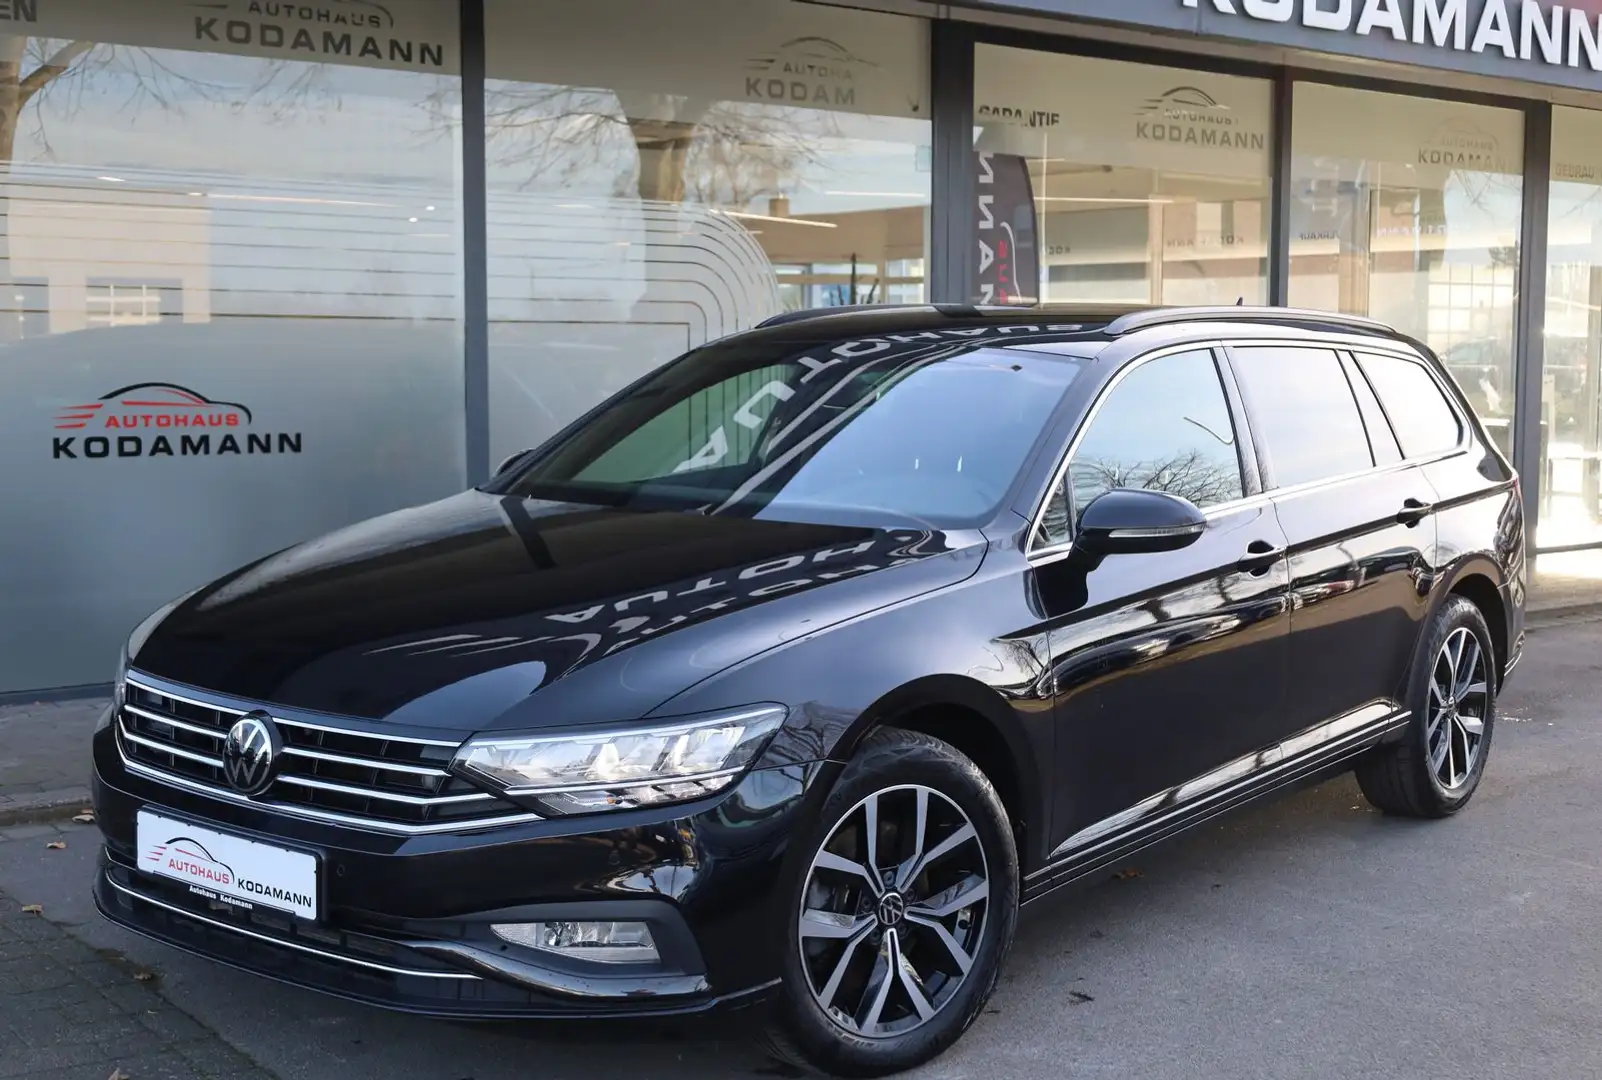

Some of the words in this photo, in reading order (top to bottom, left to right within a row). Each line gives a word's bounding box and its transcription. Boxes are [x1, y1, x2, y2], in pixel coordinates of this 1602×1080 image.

[249, 0, 381, 29] AUTOHAUS
[195, 16, 443, 66] KODAMANN
[1183, 0, 1602, 71] DAMANN
[1135, 121, 1264, 150] KODAMANN
[105, 413, 239, 429] AUTOHAUS
[52, 432, 302, 459] KODAMANN
[168, 858, 230, 885] AUTOHAUS
[237, 877, 312, 908] KODAMANN
[189, 884, 217, 900] Autohaus
[220, 893, 253, 910] Kodamann
